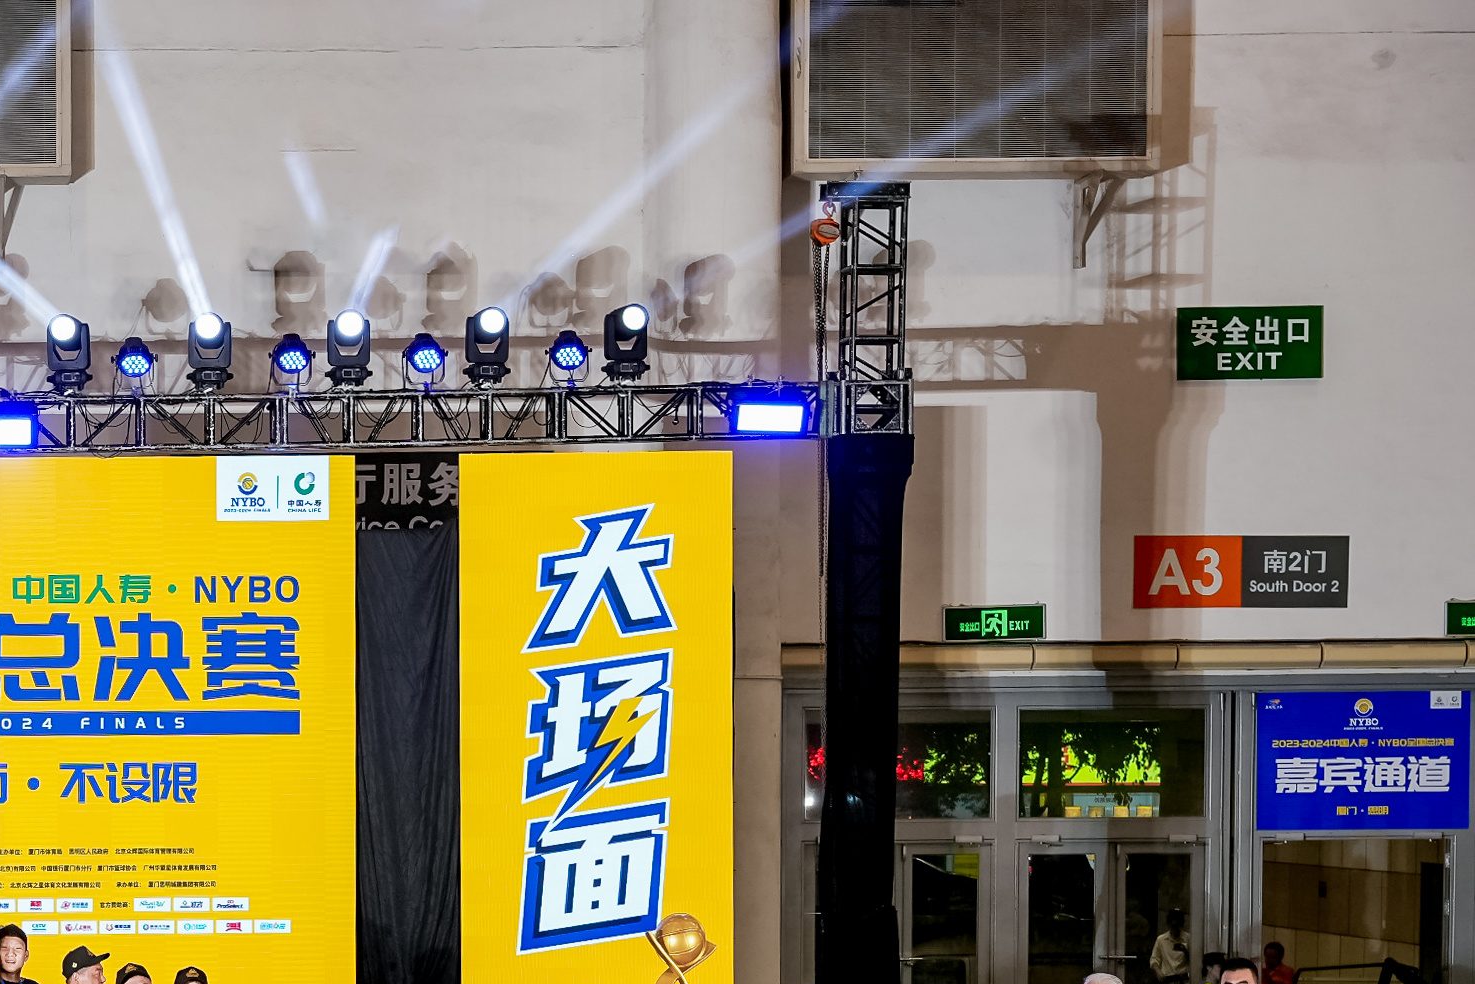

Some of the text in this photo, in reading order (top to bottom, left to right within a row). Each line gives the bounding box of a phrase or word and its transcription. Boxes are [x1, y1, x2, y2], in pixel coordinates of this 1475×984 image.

[1190, 316, 1311, 346] 安全出口
[1216, 351, 1283, 371] EXIT
[230, 497, 266, 508] NYBO
[1148, 547, 1223, 597] A3
[1262, 549, 1327, 575] 南2门
[11, 574, 152, 604] 中国人寿
[193, 575, 301, 604] NYBO
[1249, 579, 1340, 594] South Door 2
[959, 622, 980, 632] 安全出口
[1009, 620, 1030, 631] EXIT
[79, 716, 187, 730] FINALS
[516, 503, 678, 955] 大场面
[1349, 717, 1379, 726] NYBO
[1275, 755, 1451, 793] 嘉宾通道
